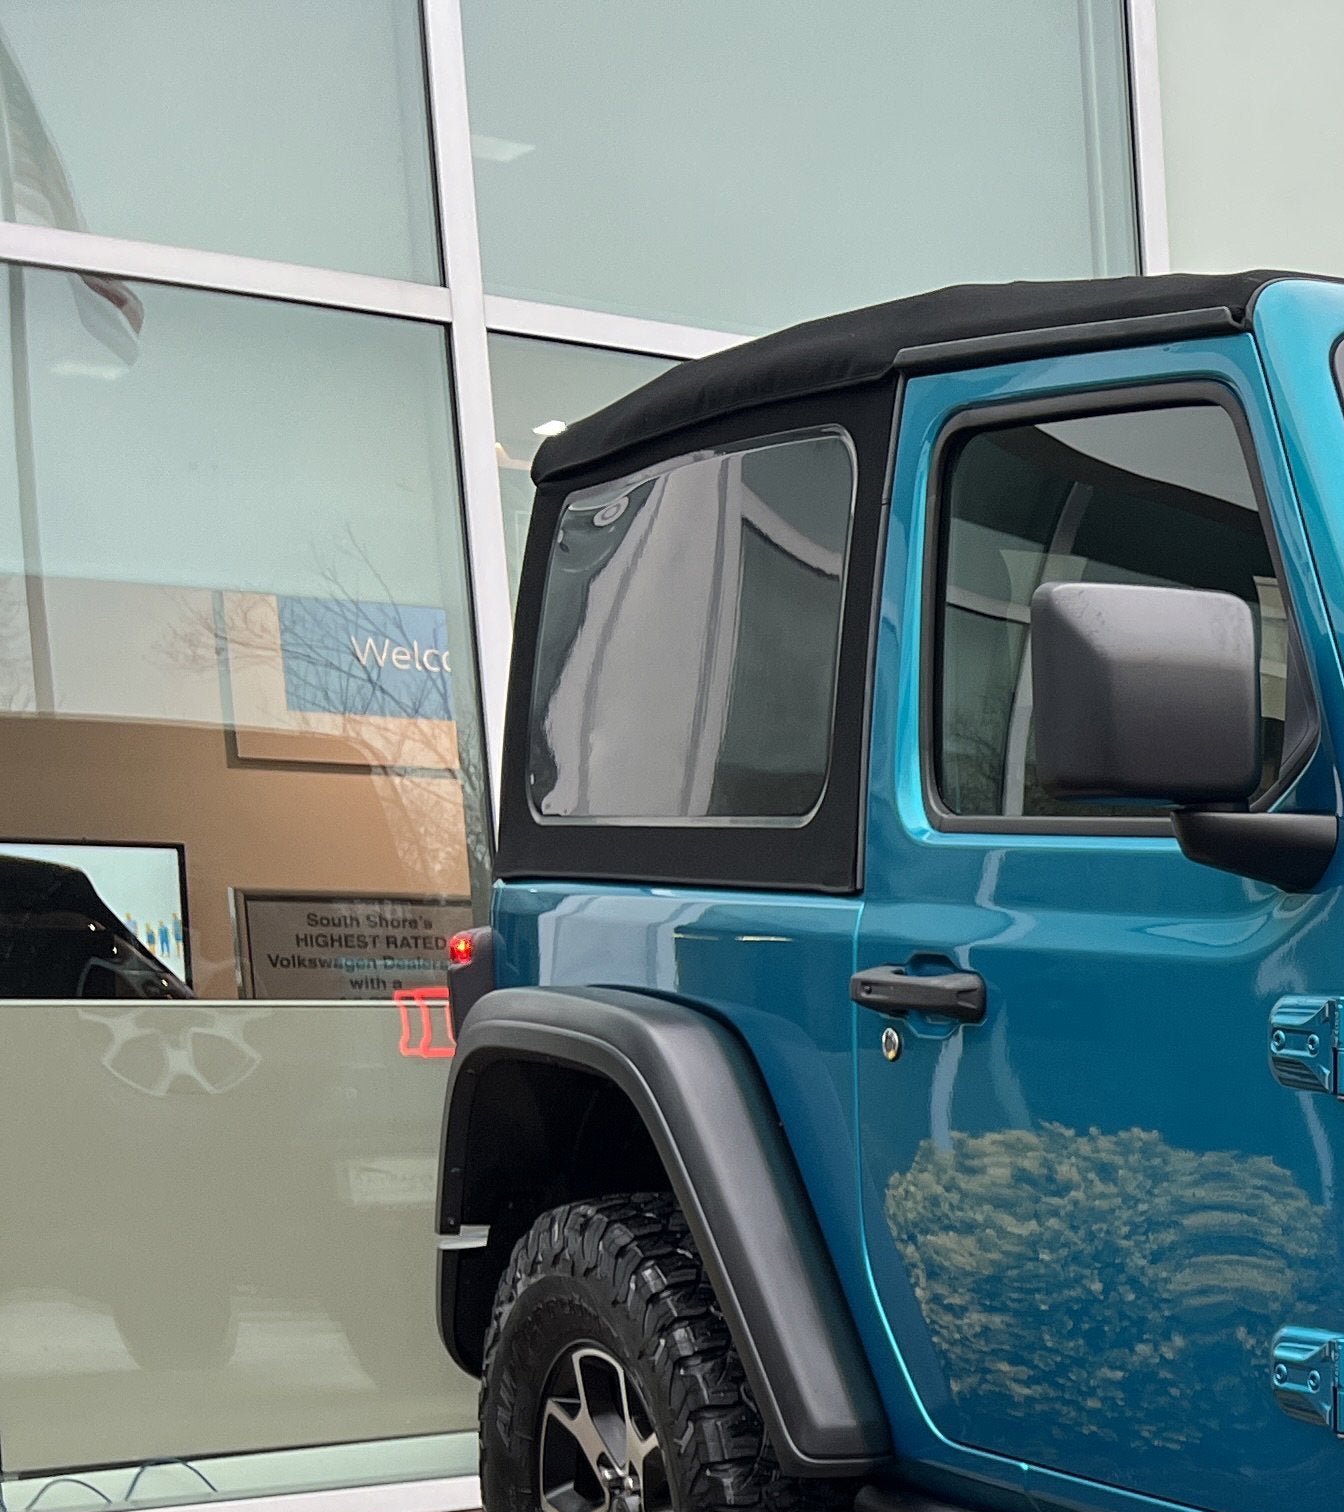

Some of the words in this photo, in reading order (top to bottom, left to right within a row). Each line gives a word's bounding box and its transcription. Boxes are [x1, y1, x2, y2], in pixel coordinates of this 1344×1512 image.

[306, 912, 361, 928] South
[366, 914, 433, 930] Shore's
[295, 933, 379, 949] HIGHEST
[386, 934, 447, 950] RATED
[267, 953, 377, 973] Volkswagen
[350, 977, 387, 990] with
